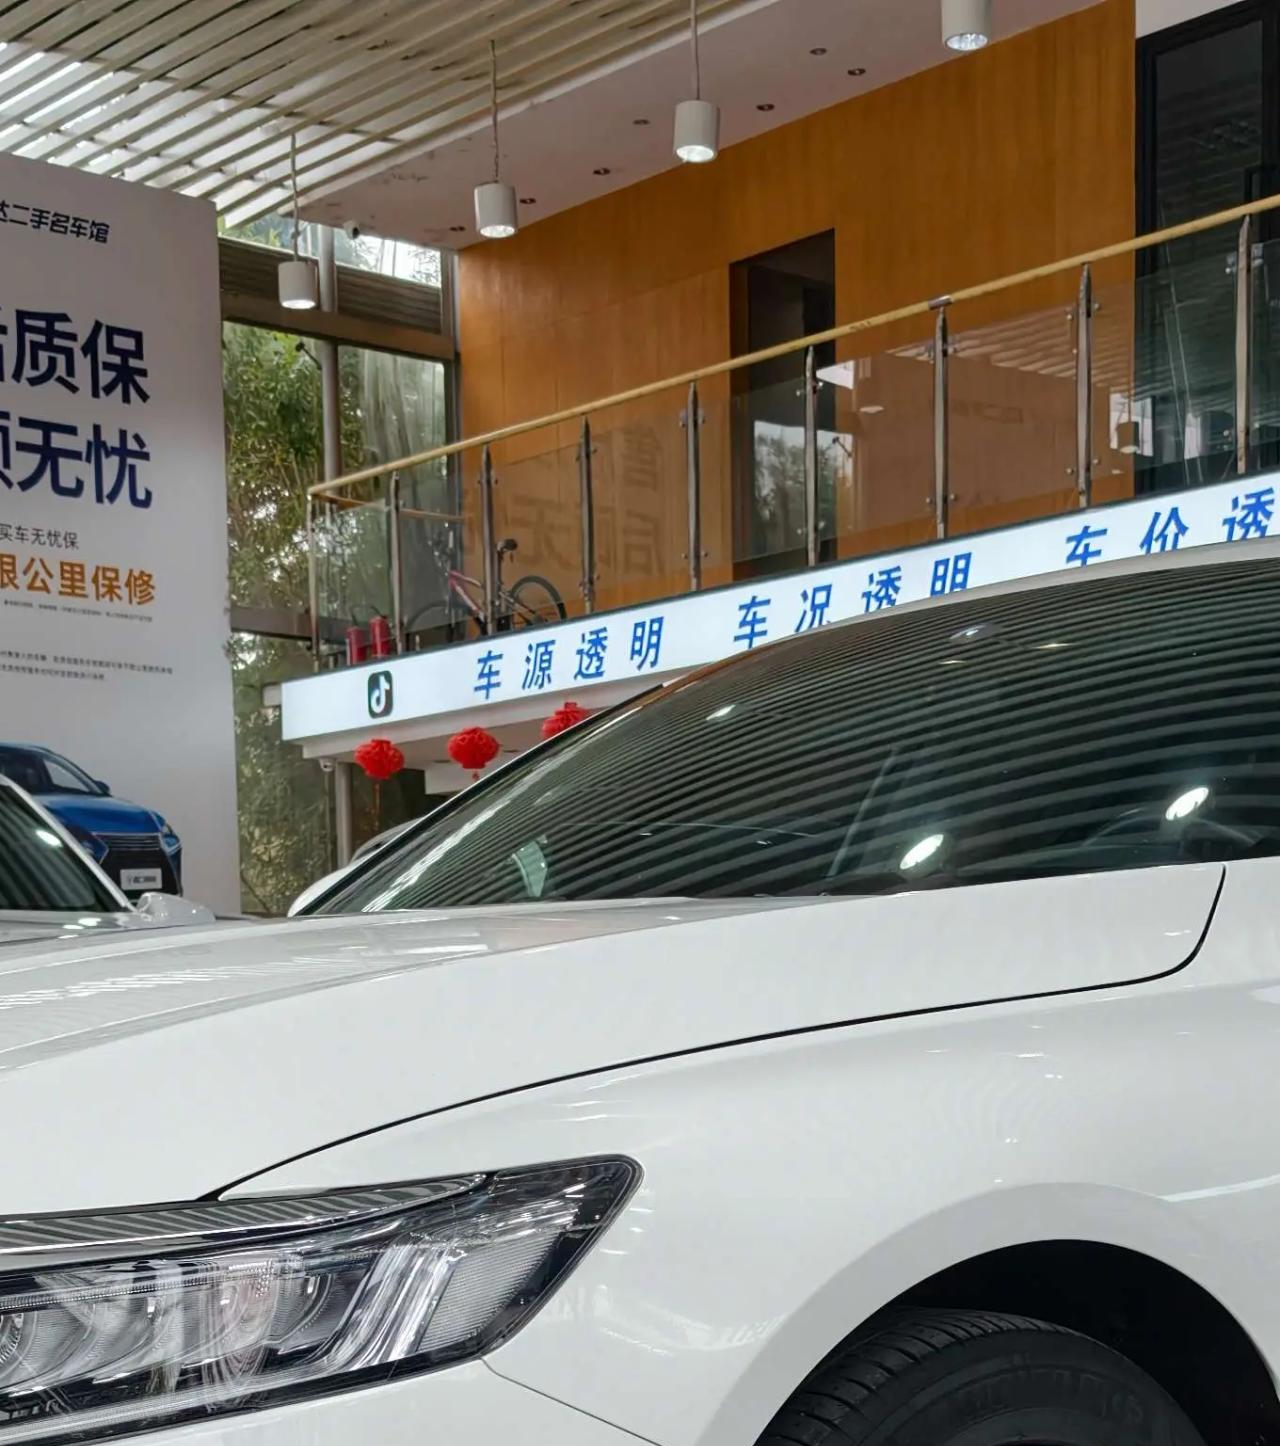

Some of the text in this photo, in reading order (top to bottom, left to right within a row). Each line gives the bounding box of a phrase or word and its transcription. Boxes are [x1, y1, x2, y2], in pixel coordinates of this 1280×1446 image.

[732, 551, 973, 650] 车况透明
[473, 616, 665, 701] 车源透明
